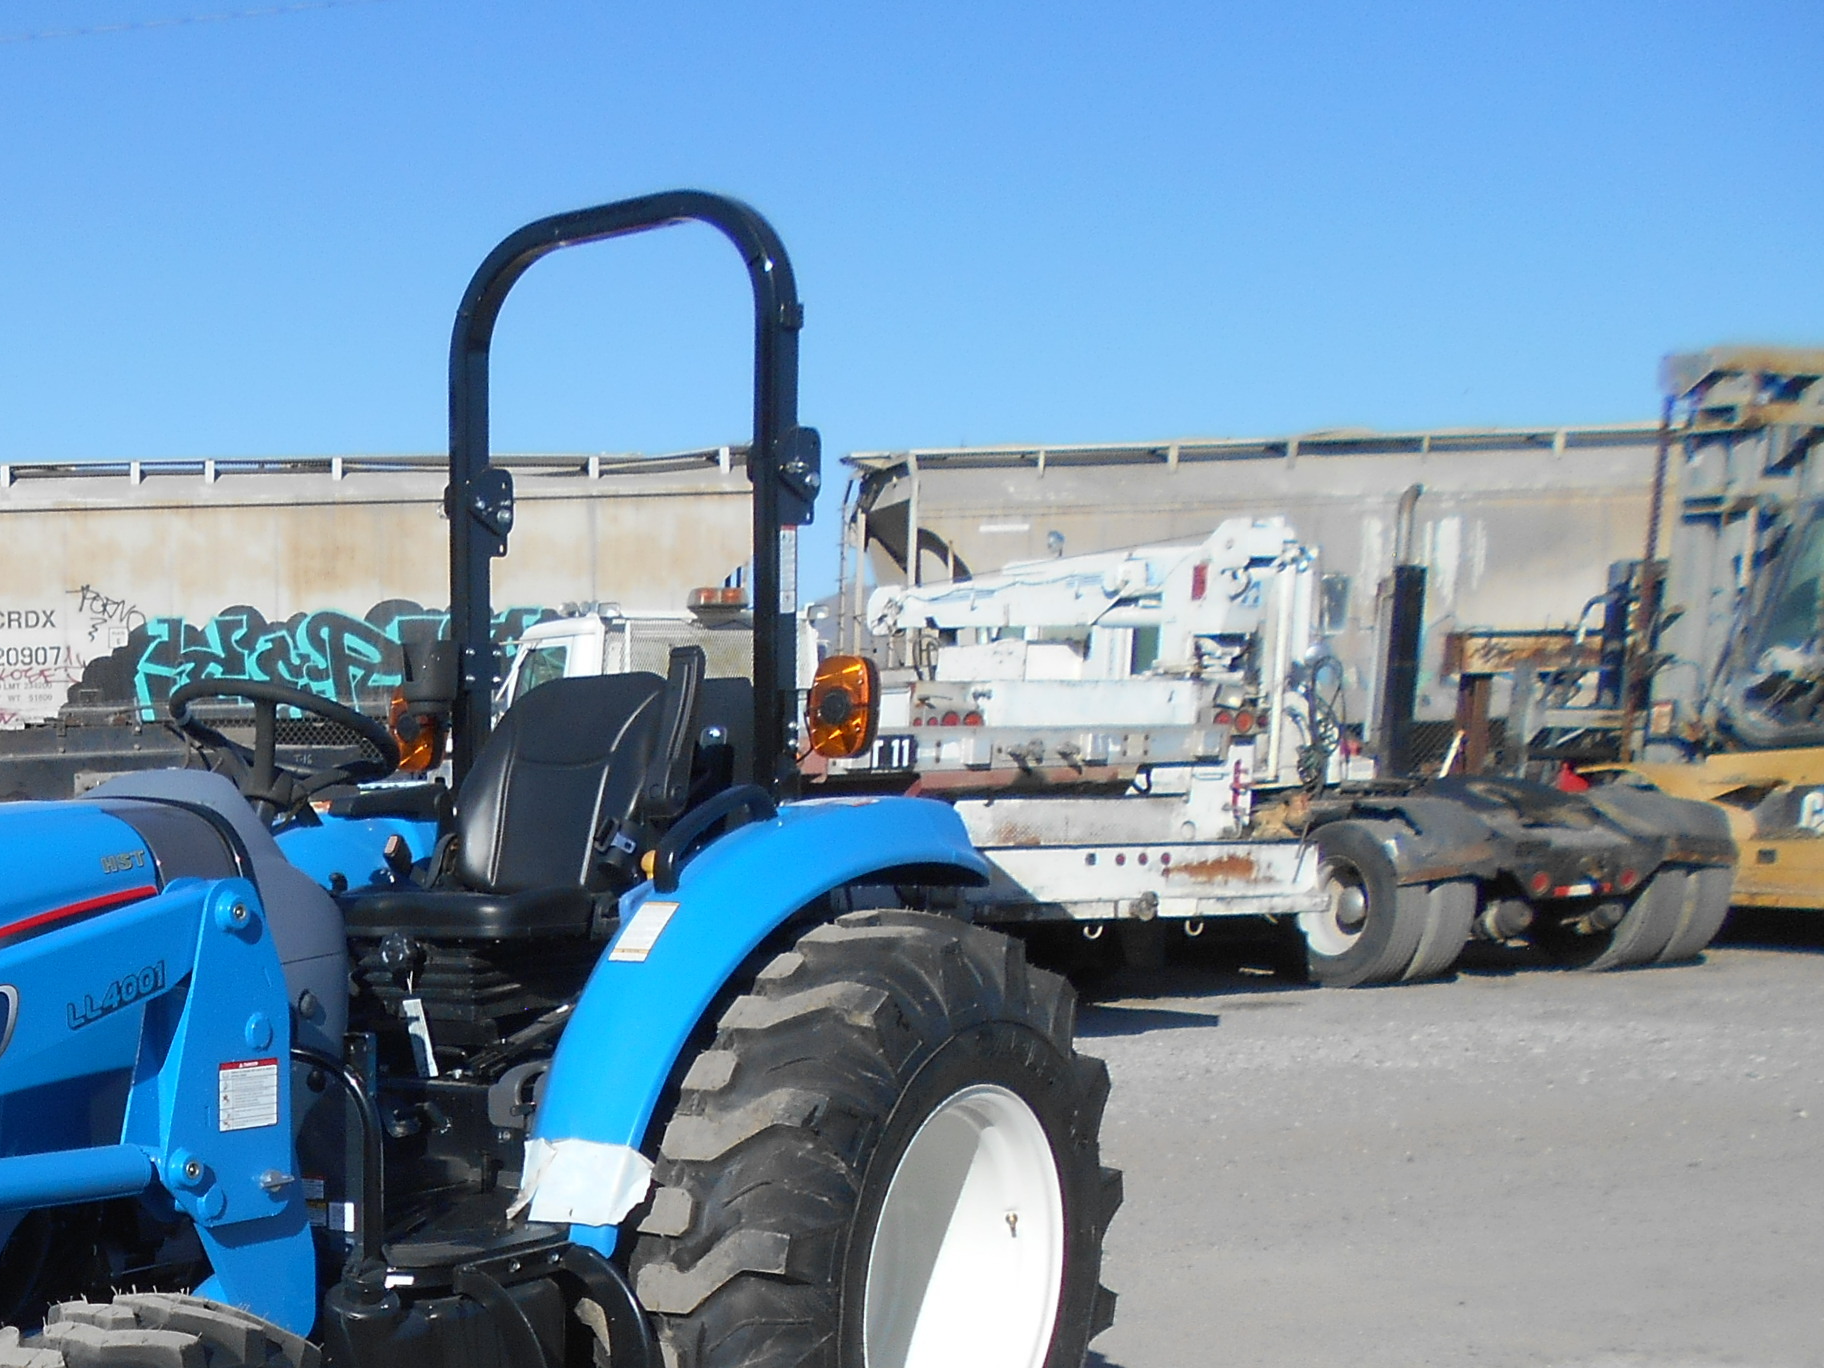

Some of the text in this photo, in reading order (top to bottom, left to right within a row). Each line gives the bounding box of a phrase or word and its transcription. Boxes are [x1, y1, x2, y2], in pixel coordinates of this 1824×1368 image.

[891, 738, 910, 768] 11
[100, 850, 146, 874] HST
[66, 960, 166, 1031] LL4001
